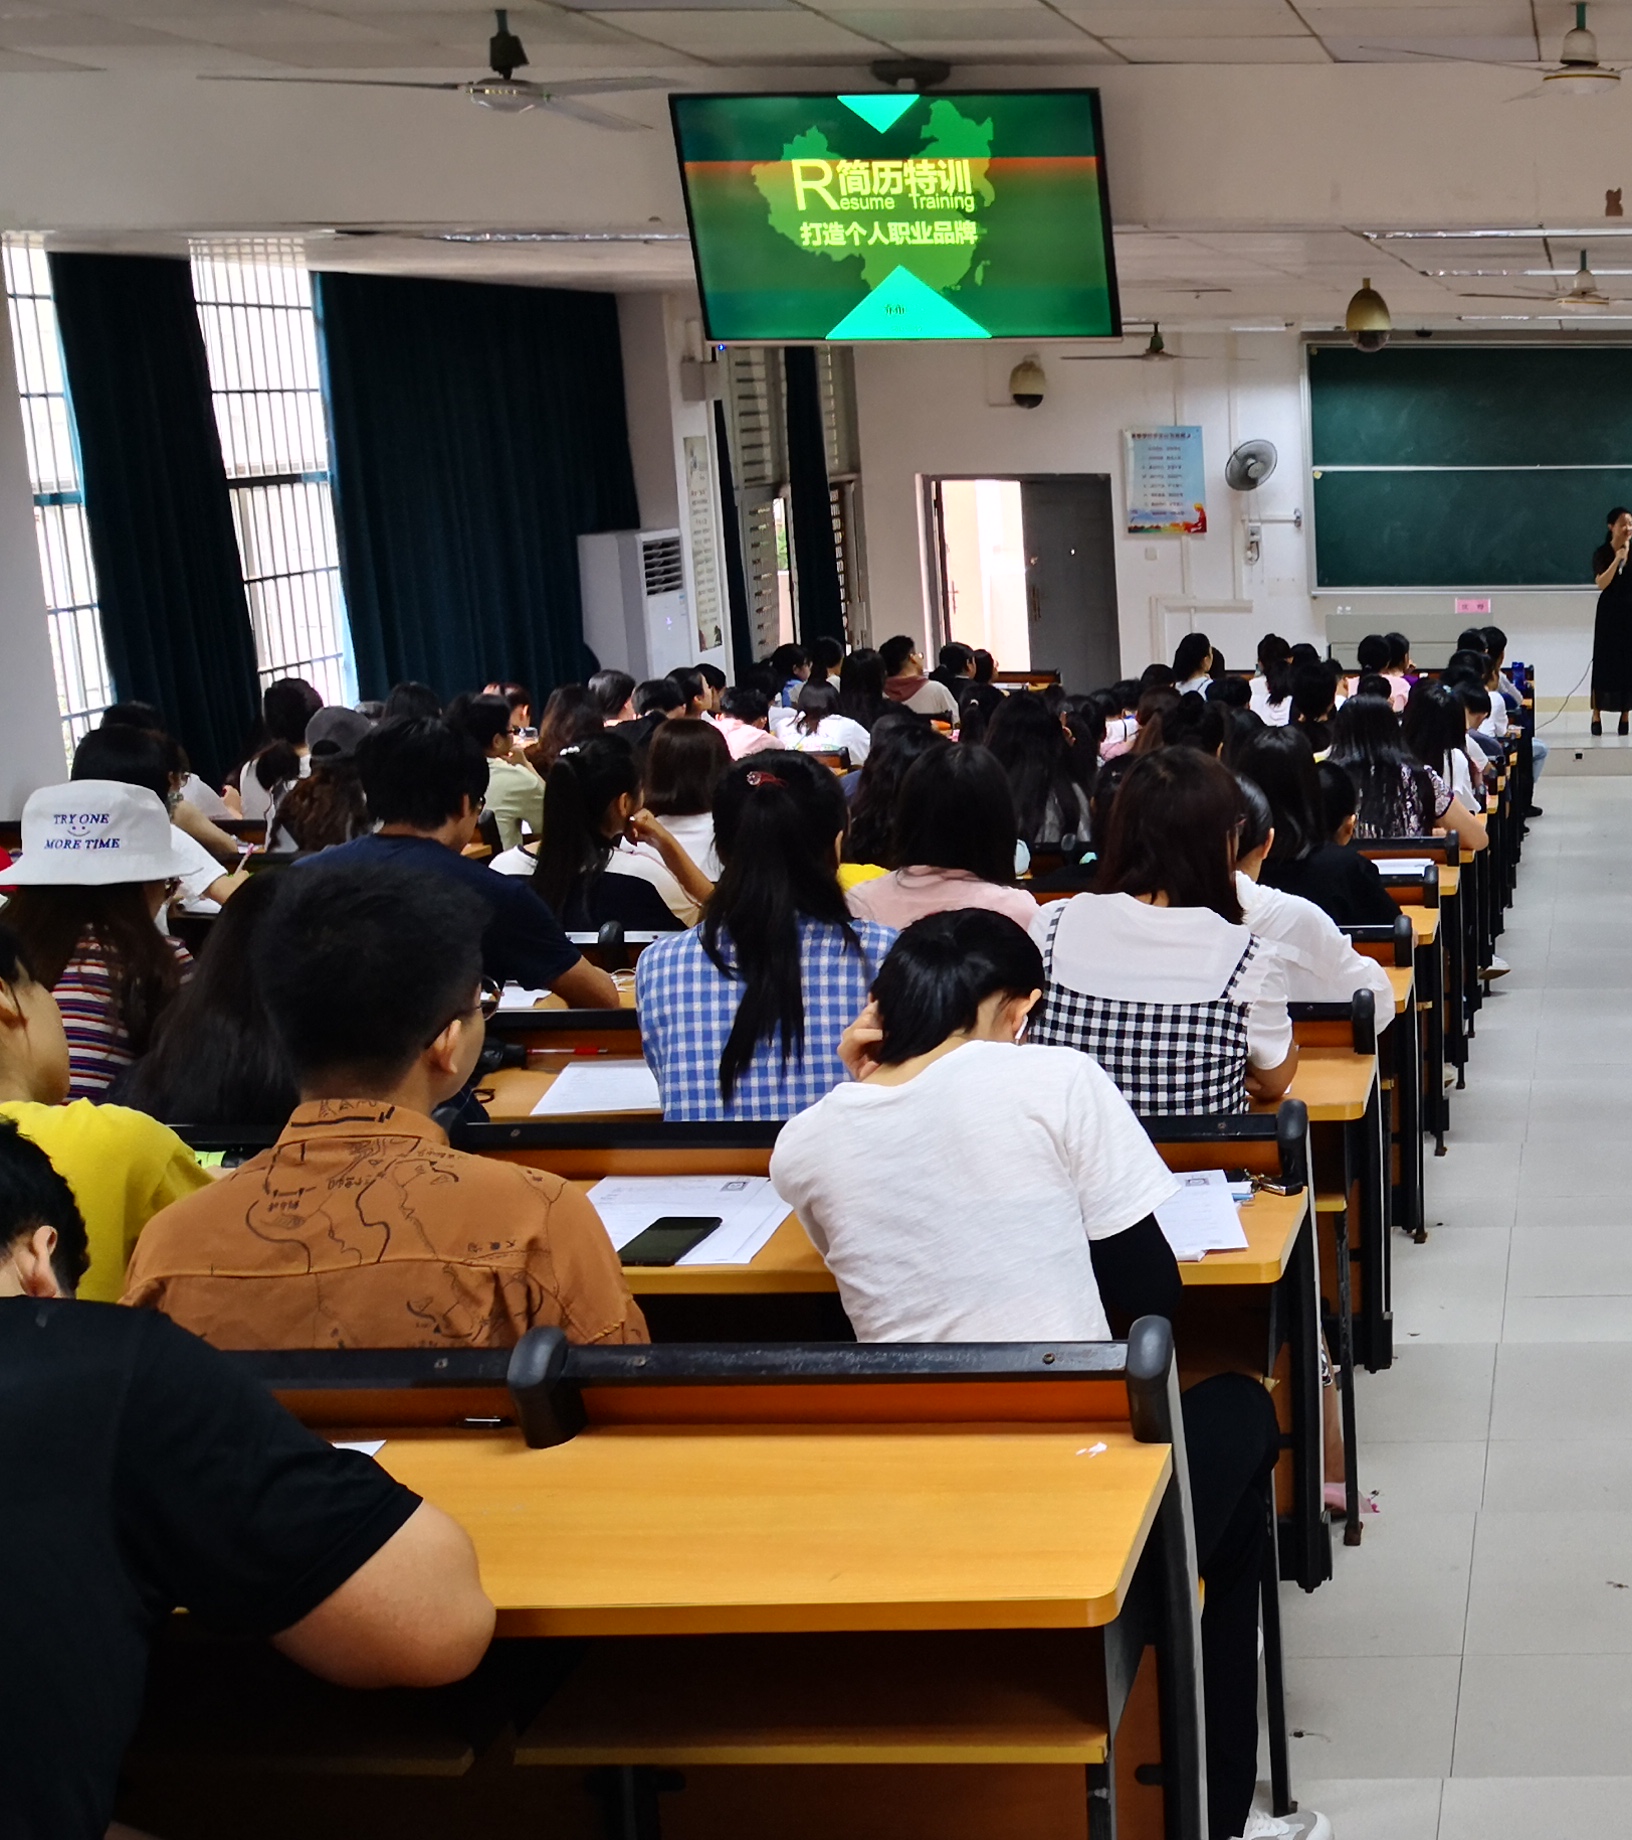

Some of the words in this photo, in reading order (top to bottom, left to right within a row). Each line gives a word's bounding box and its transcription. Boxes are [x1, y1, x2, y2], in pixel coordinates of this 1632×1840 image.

[836, 159, 973, 196] 简历特训
[908, 193, 975, 212] Training
[800, 220, 978, 246] 打造个人职业品牌
[53, 813, 78, 825] TRY
[79, 813, 110, 825] ONE
[44, 838, 82, 849] MORE
[84, 838, 120, 849] TIME
